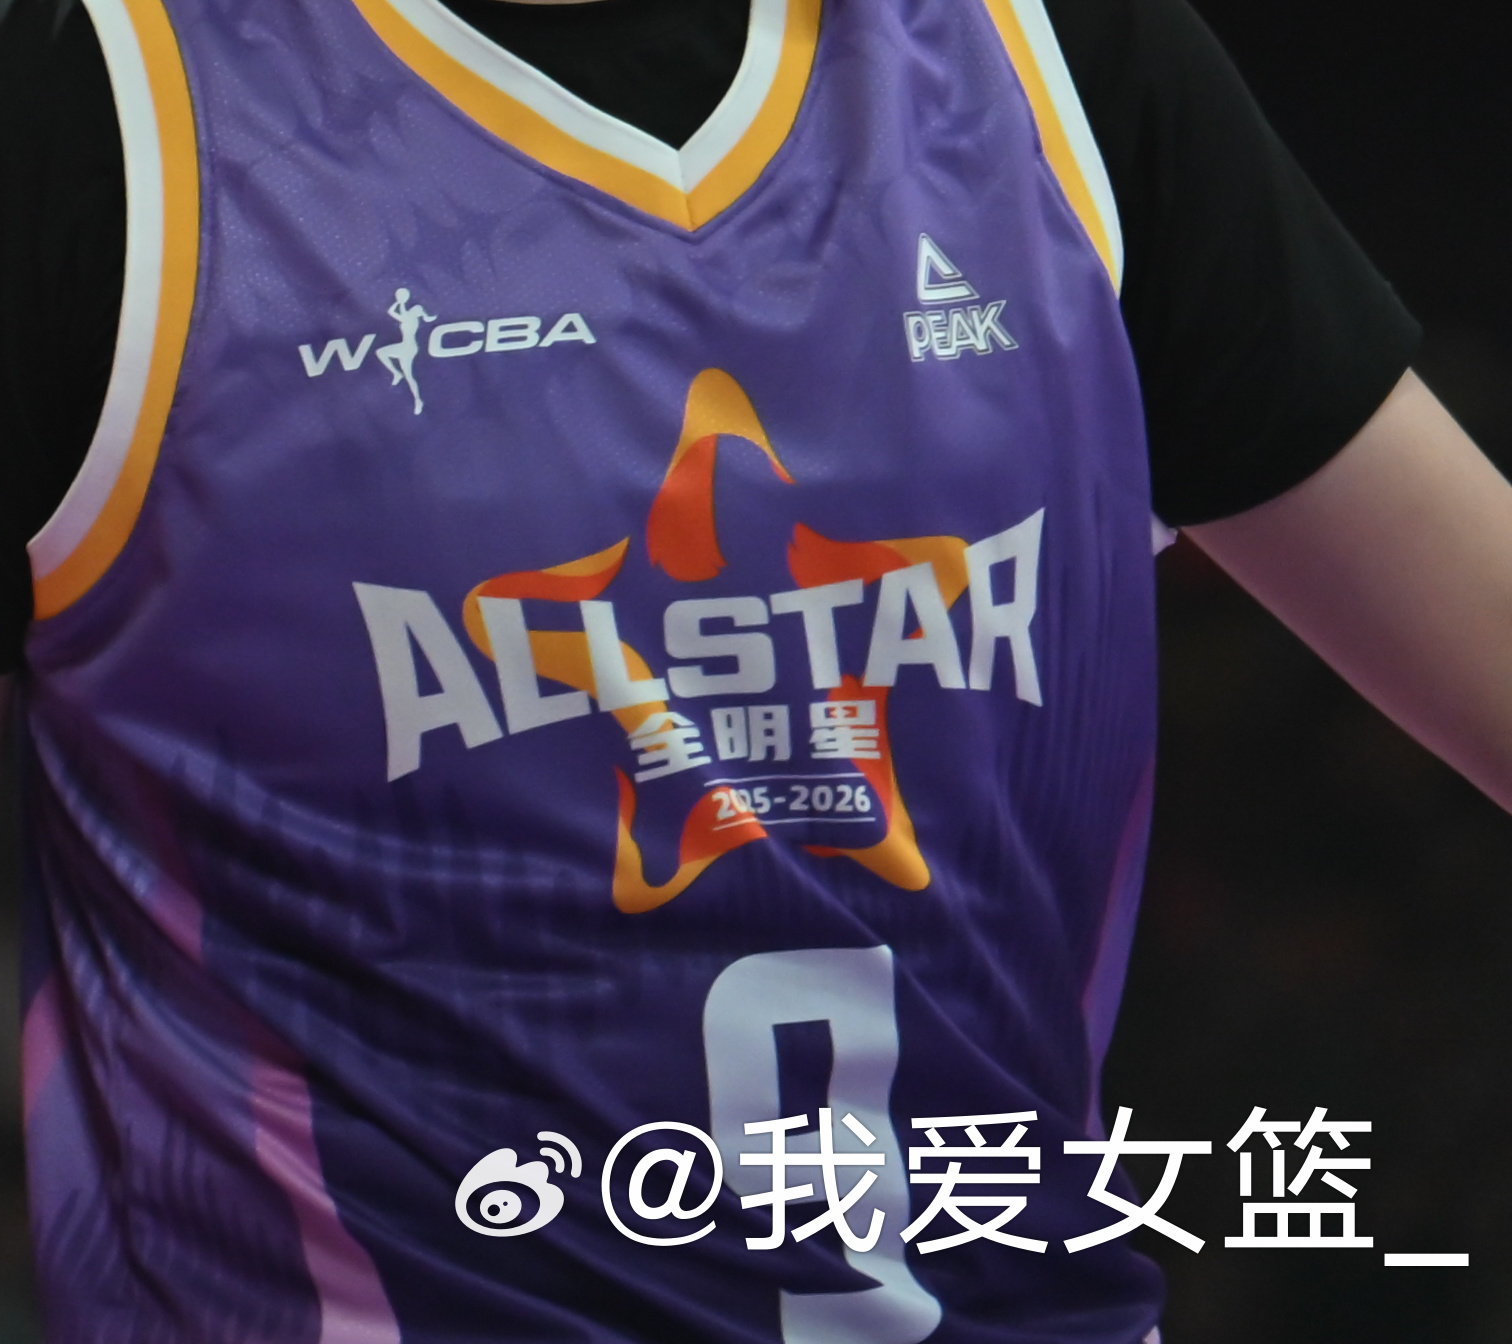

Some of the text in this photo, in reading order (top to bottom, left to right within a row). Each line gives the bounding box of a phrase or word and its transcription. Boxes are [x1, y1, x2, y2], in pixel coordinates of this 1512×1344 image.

[903, 300, 1019, 362] PEAK
[627, 700, 882, 783] 全明星
